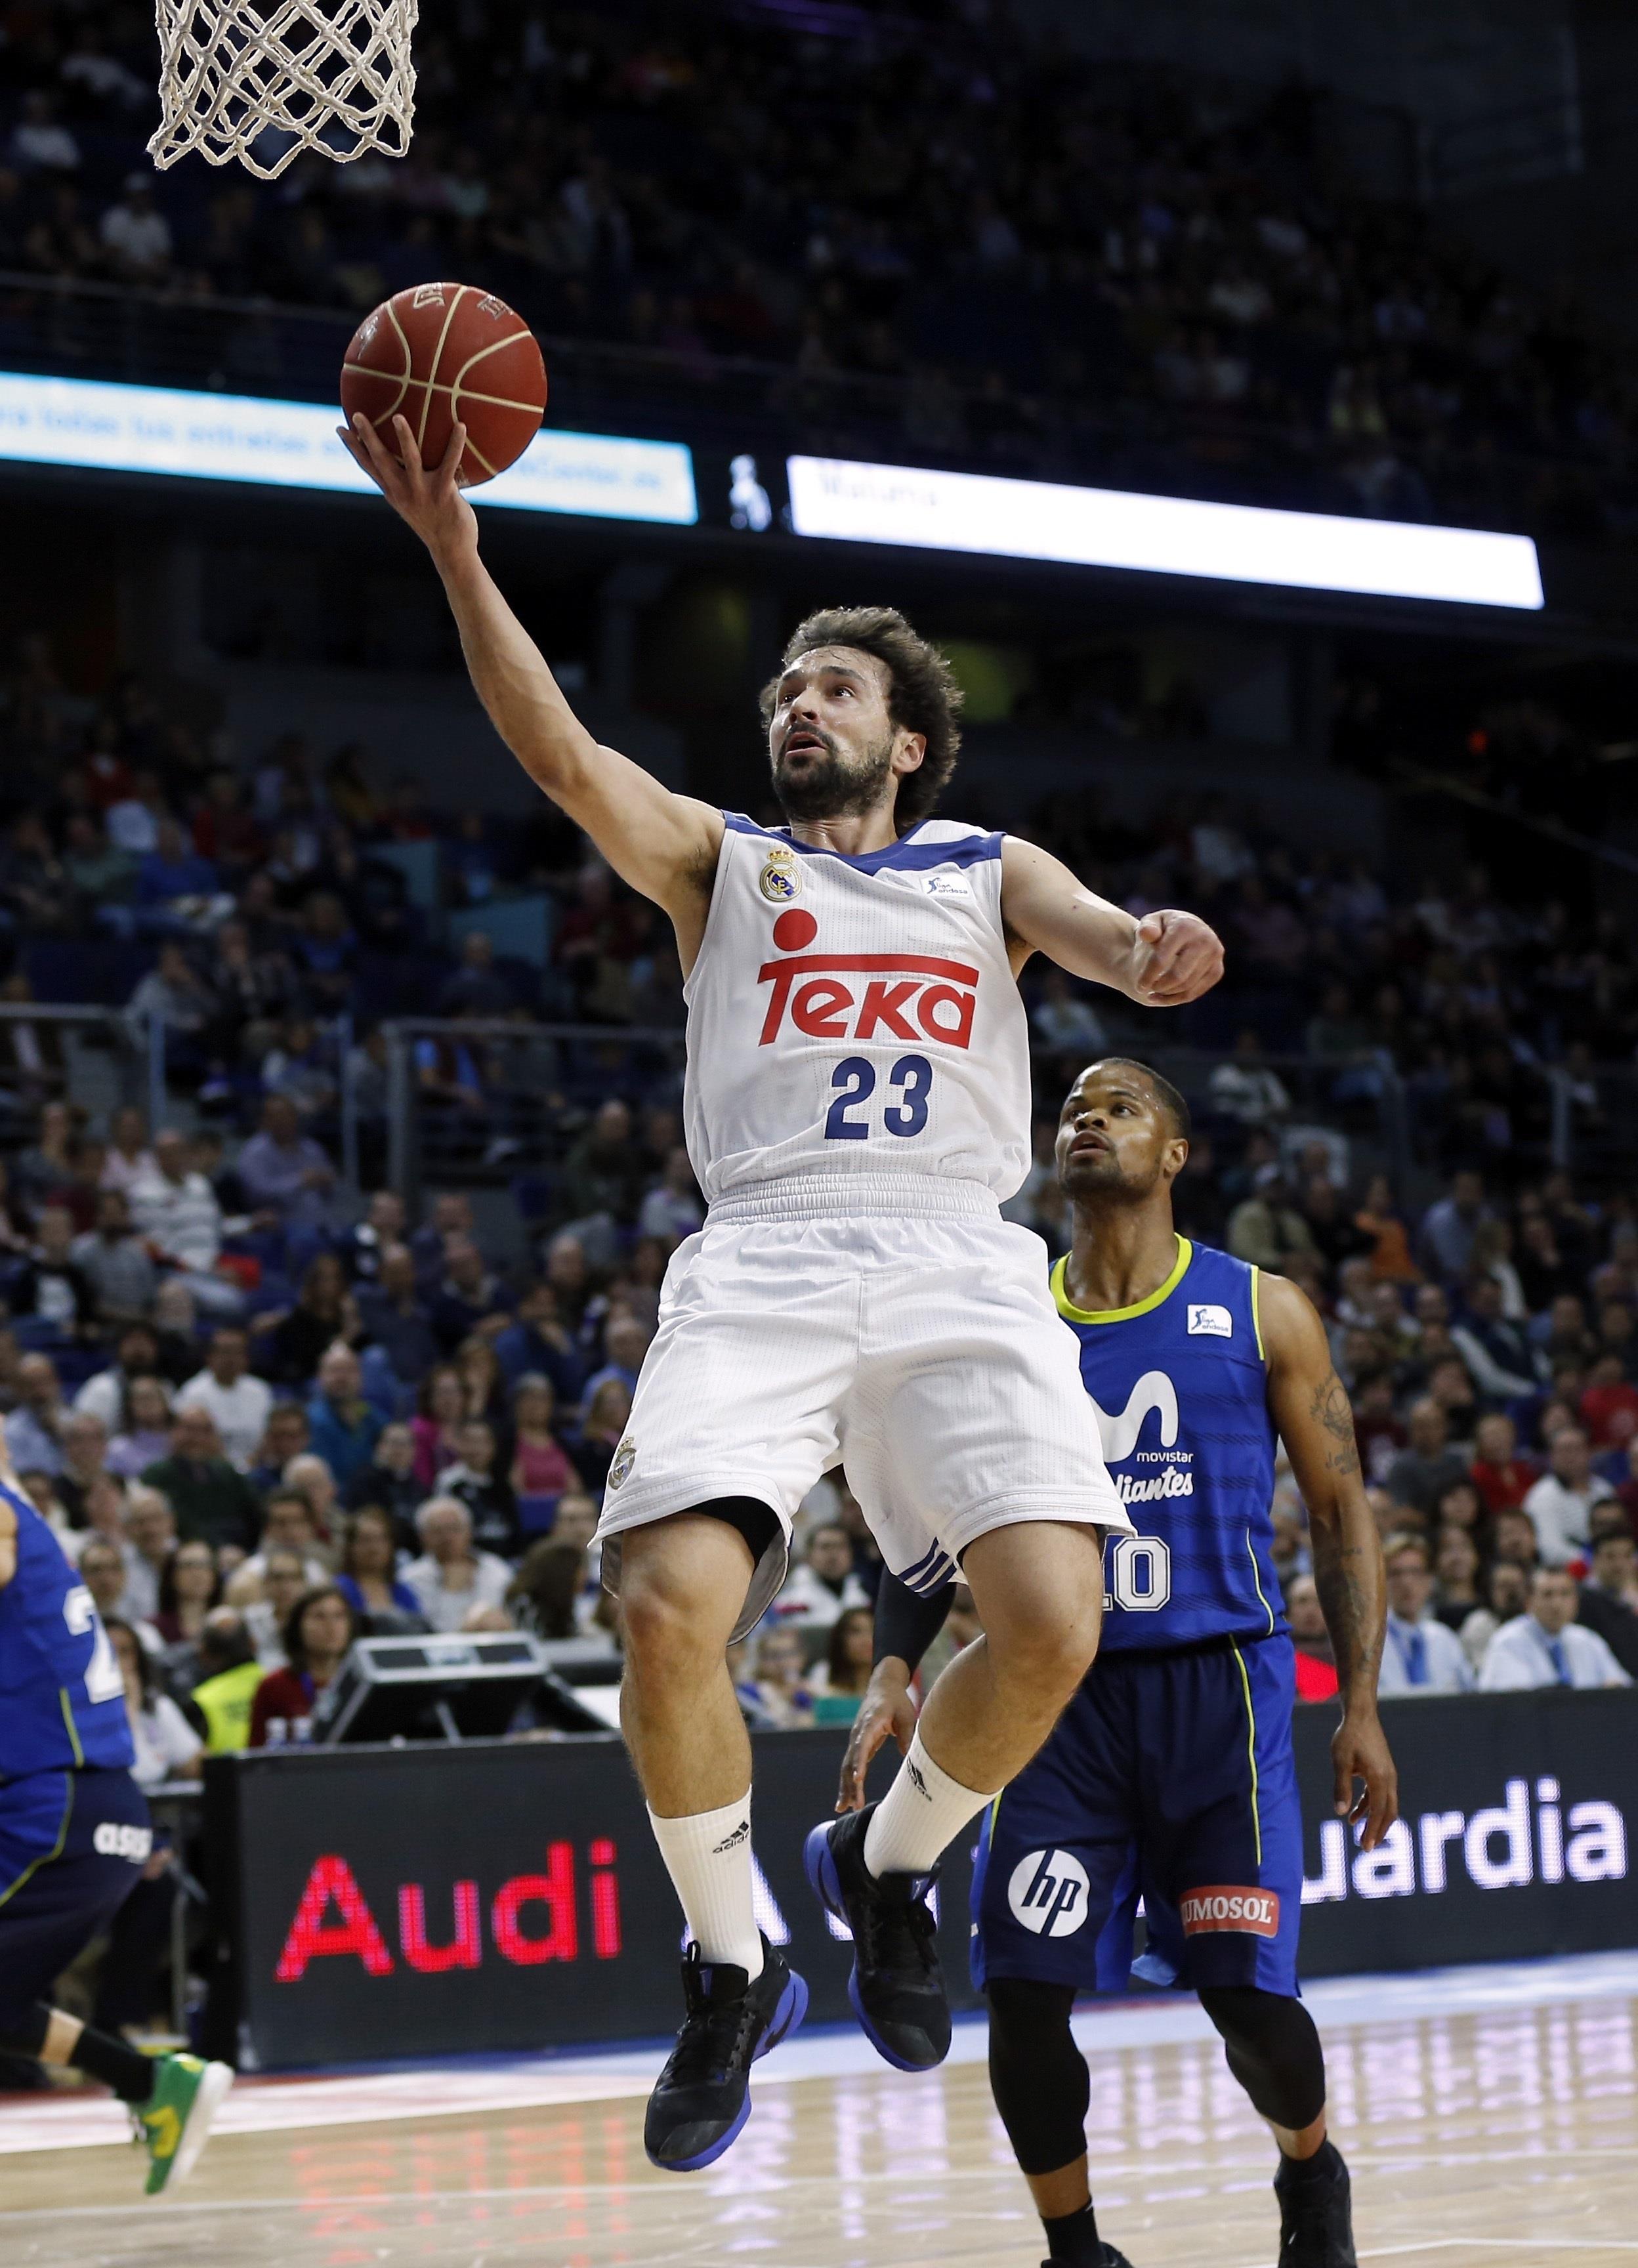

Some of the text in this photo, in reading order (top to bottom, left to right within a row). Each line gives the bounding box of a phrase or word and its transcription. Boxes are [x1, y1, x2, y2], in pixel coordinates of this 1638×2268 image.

[824, 1055, 933, 1141] 23
[1137, 1451, 1194, 1463] movistar
[1103, 1536, 1171, 1612] 0
[1301, 1775, 1628, 1904] uardia
[275, 1838, 622, 1982] Audi
[1020, 1849, 1083, 1938] hp
[1182, 1896, 1272, 1924] UMOSOL
